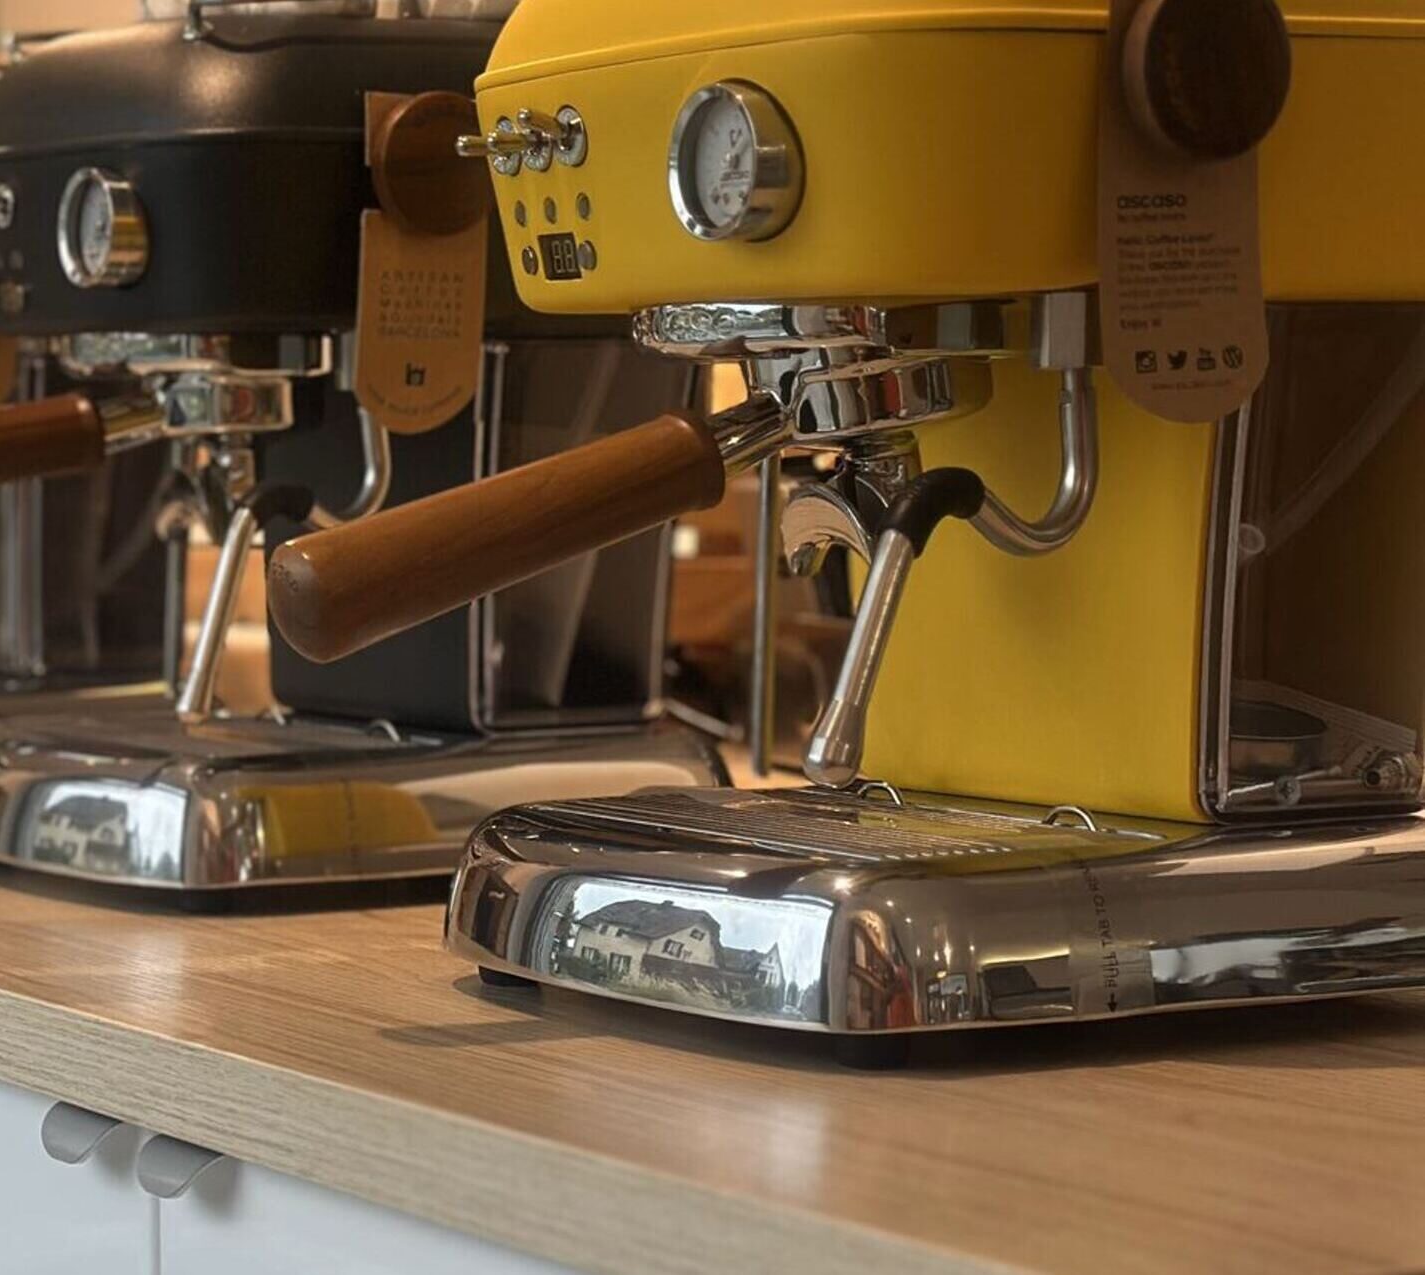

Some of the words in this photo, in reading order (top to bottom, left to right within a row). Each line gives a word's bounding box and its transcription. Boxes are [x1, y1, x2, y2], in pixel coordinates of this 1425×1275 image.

[1117, 193, 1187, 209] ascaso
[1098, 919, 1113, 948] TAB
[1103, 951, 1120, 988] PULL
